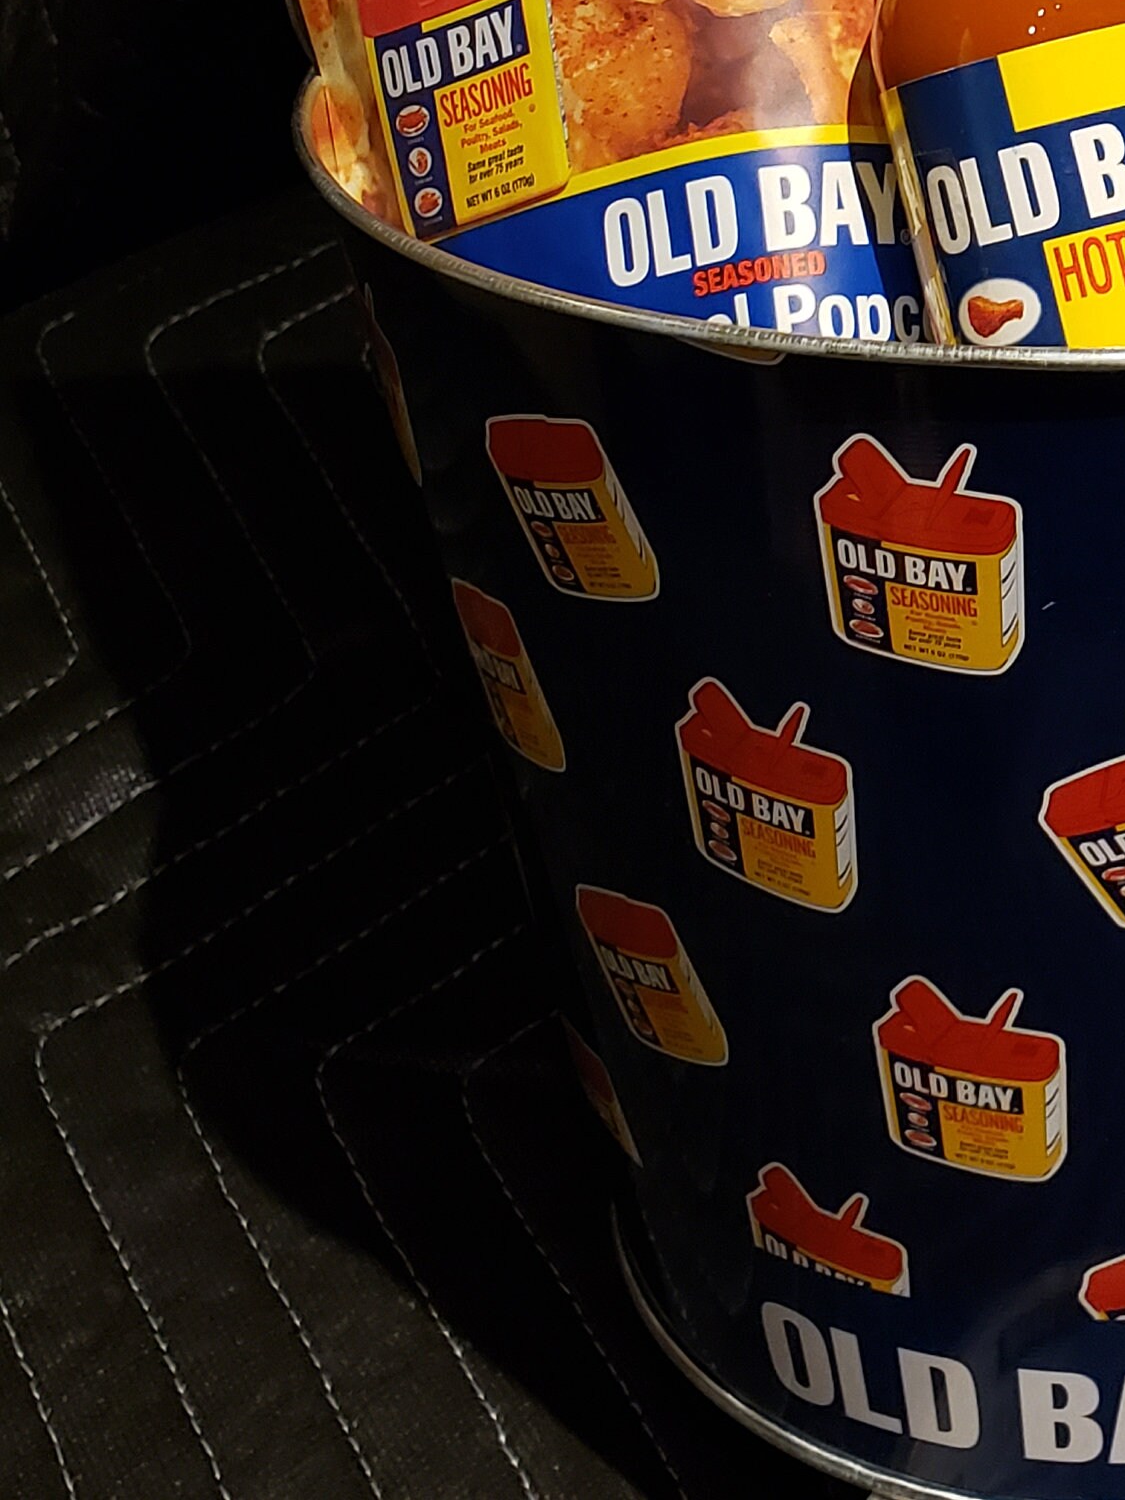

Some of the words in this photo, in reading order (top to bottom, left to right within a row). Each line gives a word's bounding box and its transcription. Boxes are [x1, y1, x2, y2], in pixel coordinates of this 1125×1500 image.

[381, 36, 443, 99] OLD
[447, 4, 513, 78] BAY
[439, 62, 533, 128] SEASONING
[466, 194, 480, 209] NET
[480, 187, 493, 203] WT
[604, 174, 739, 288] OLD
[757, 160, 898, 252] BAY
[926, 141, 1060, 255] OLD
[692, 250, 827, 298] SEASONED
[837, 538, 896, 579] OLD
[904, 555, 968, 592] BAY
[889, 586, 978, 618] SEASONING
[695, 766, 745, 812] OLD
[751, 792, 806, 834] BAY
[893, 1061, 949, 1099] OLD
[955, 1080, 1014, 1112] BAY
[761, 1301, 980, 1450] OLD
